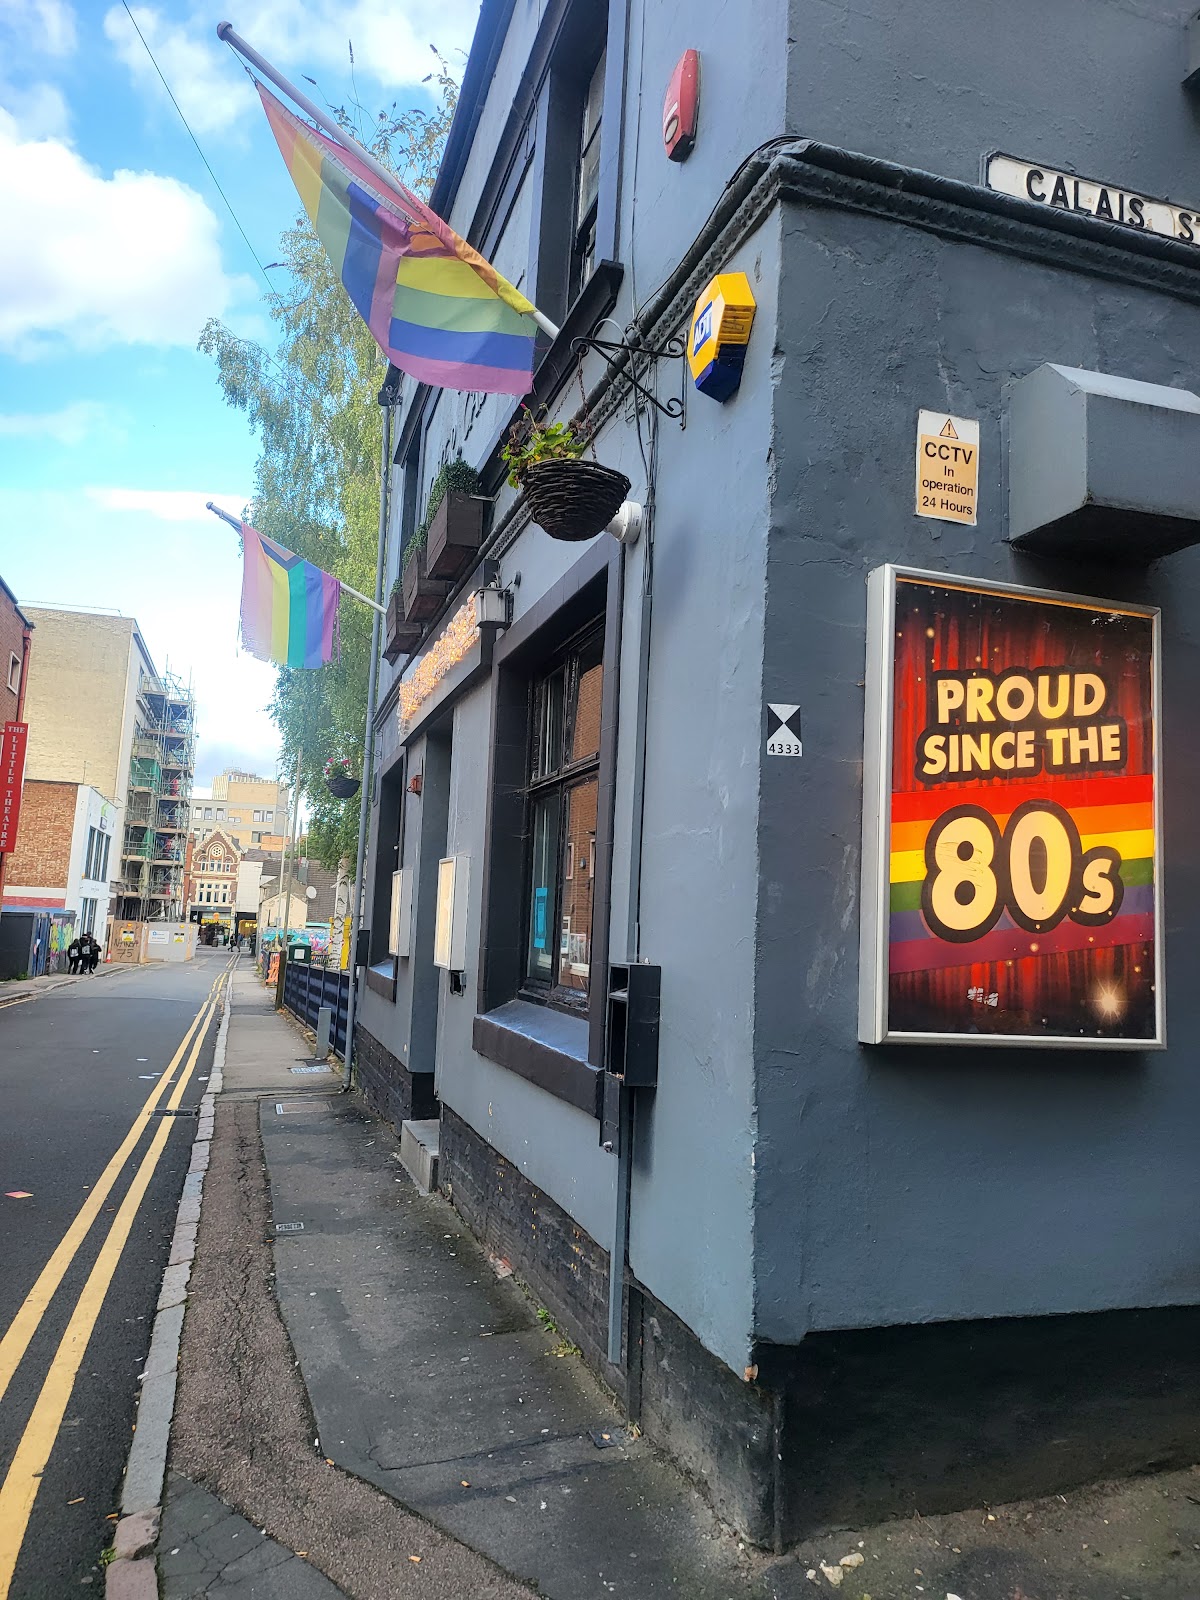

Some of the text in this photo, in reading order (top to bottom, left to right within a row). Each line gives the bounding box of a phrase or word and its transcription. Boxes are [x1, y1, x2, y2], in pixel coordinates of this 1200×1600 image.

[1026, 169, 1200, 242] CALAIS S
[693, 305, 713, 352] ADT
[924, 441, 973, 465] CCTV
[922, 479, 974, 497] operation
[943, 465, 955, 477] In
[922, 495, 973, 515] 24 Hours
[937, 673, 1106, 724] PROUD
[8, 725, 26, 734] THE
[768, 743, 800, 755] 4333
[922, 724, 1121, 775] SINCE THE
[0, 735, 19, 848] LITTLE THEATRE
[931, 810, 1115, 931] 80s
